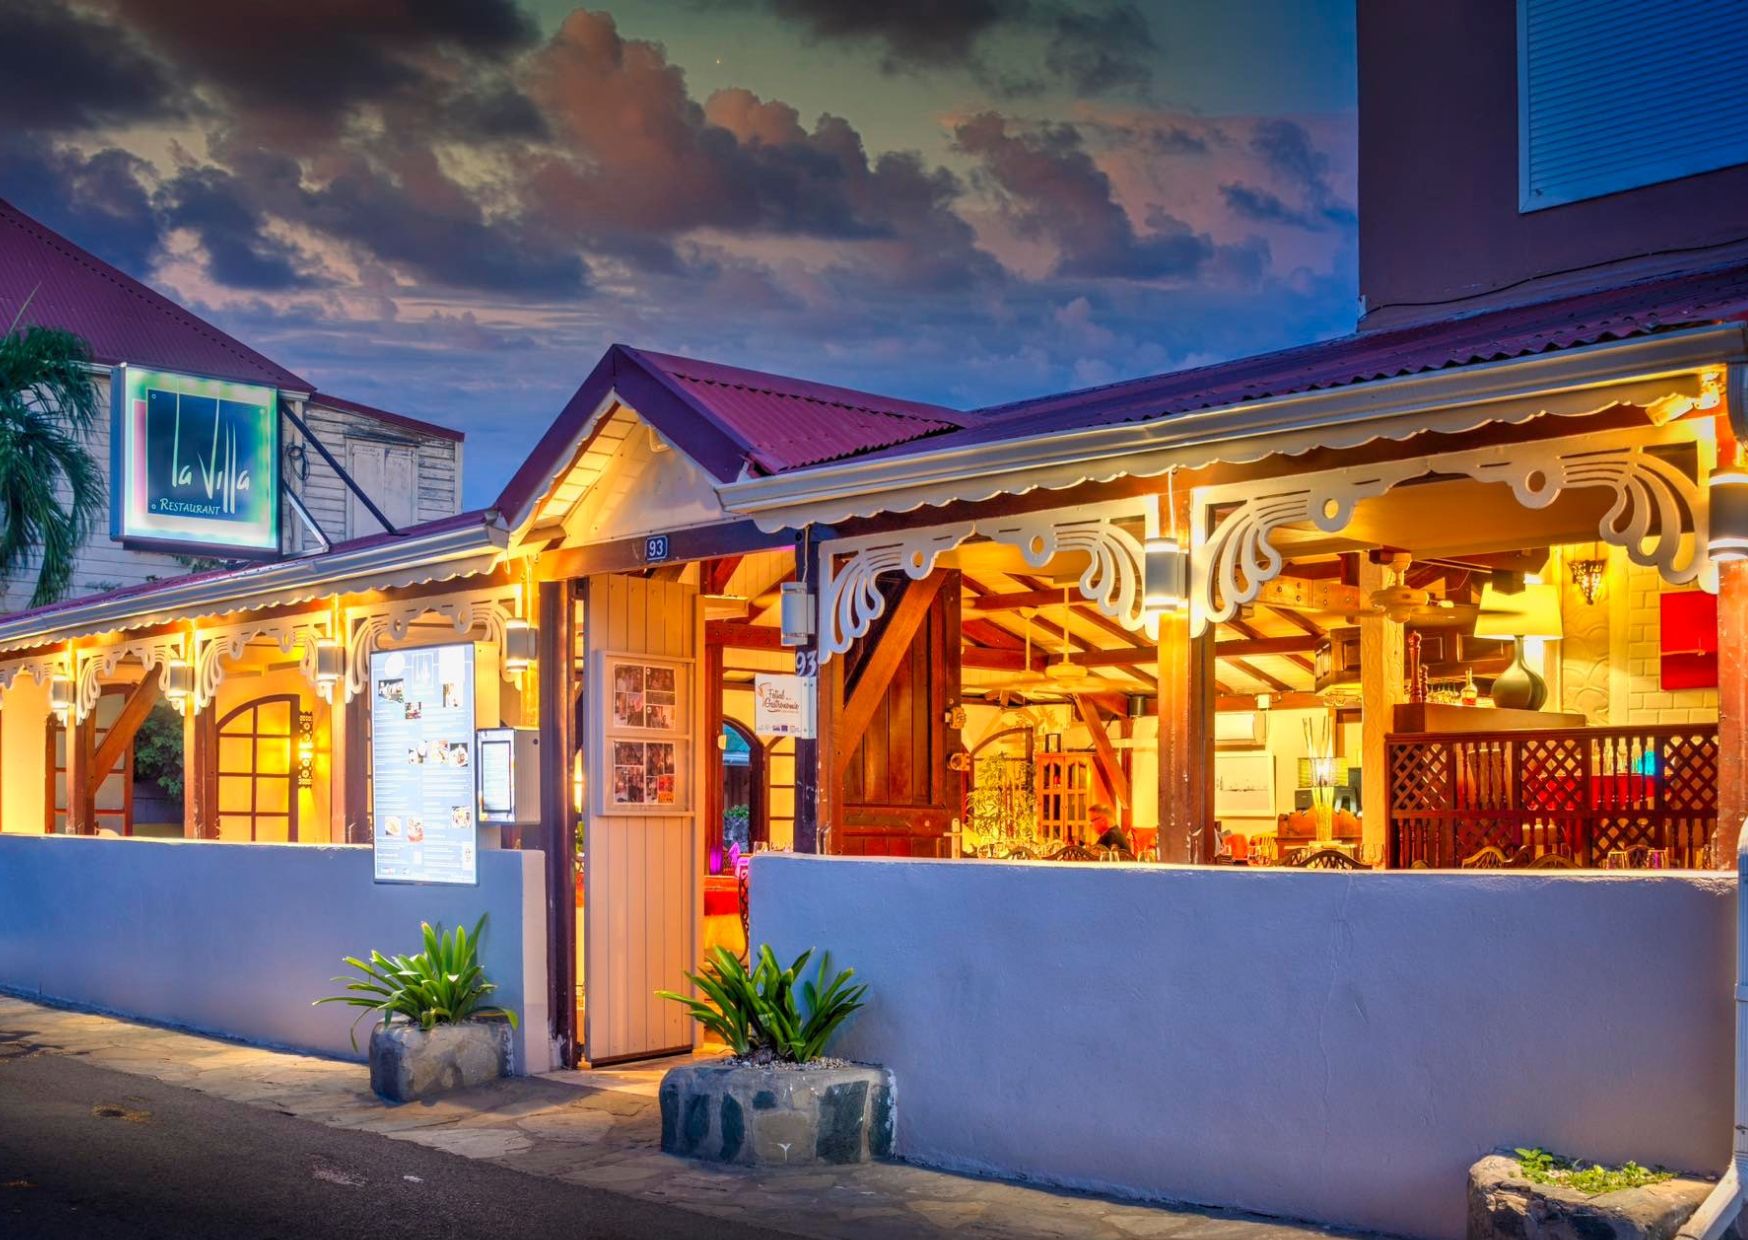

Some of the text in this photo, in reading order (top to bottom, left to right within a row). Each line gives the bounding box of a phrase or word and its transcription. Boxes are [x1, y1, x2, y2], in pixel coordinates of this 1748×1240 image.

[197, 395, 250, 514] Villa
[649, 539, 664, 557] 93
[796, 650, 817, 677] 93
